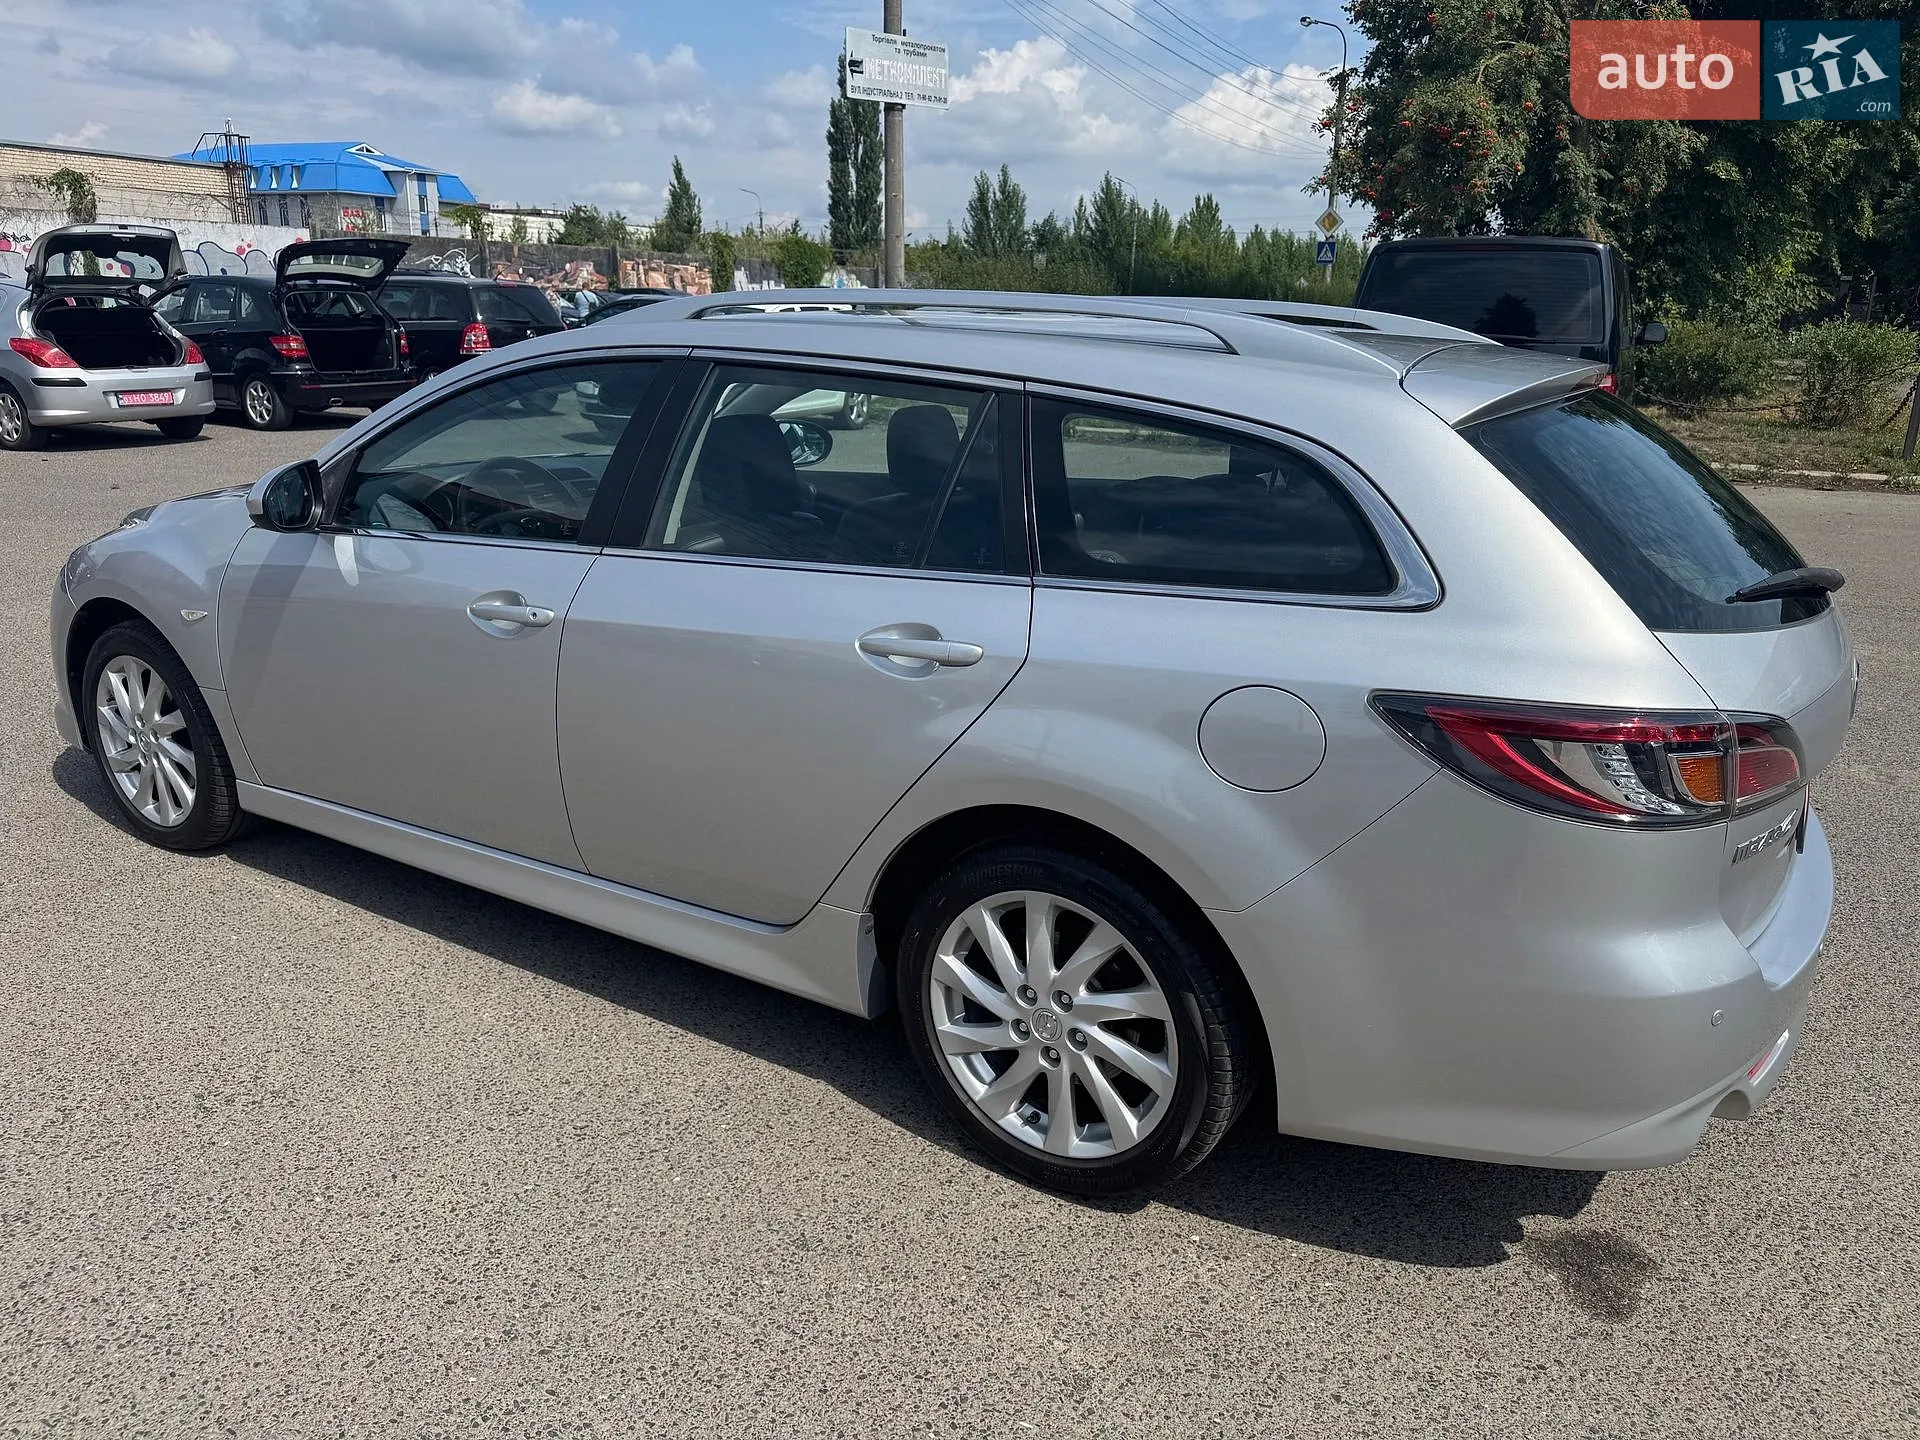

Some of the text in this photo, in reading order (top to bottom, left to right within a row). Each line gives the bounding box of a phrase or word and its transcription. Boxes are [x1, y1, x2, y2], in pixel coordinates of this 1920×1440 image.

[872, 34, 946, 53] Торгівля металопрокатом
[903, 49, 928, 58] трубами
